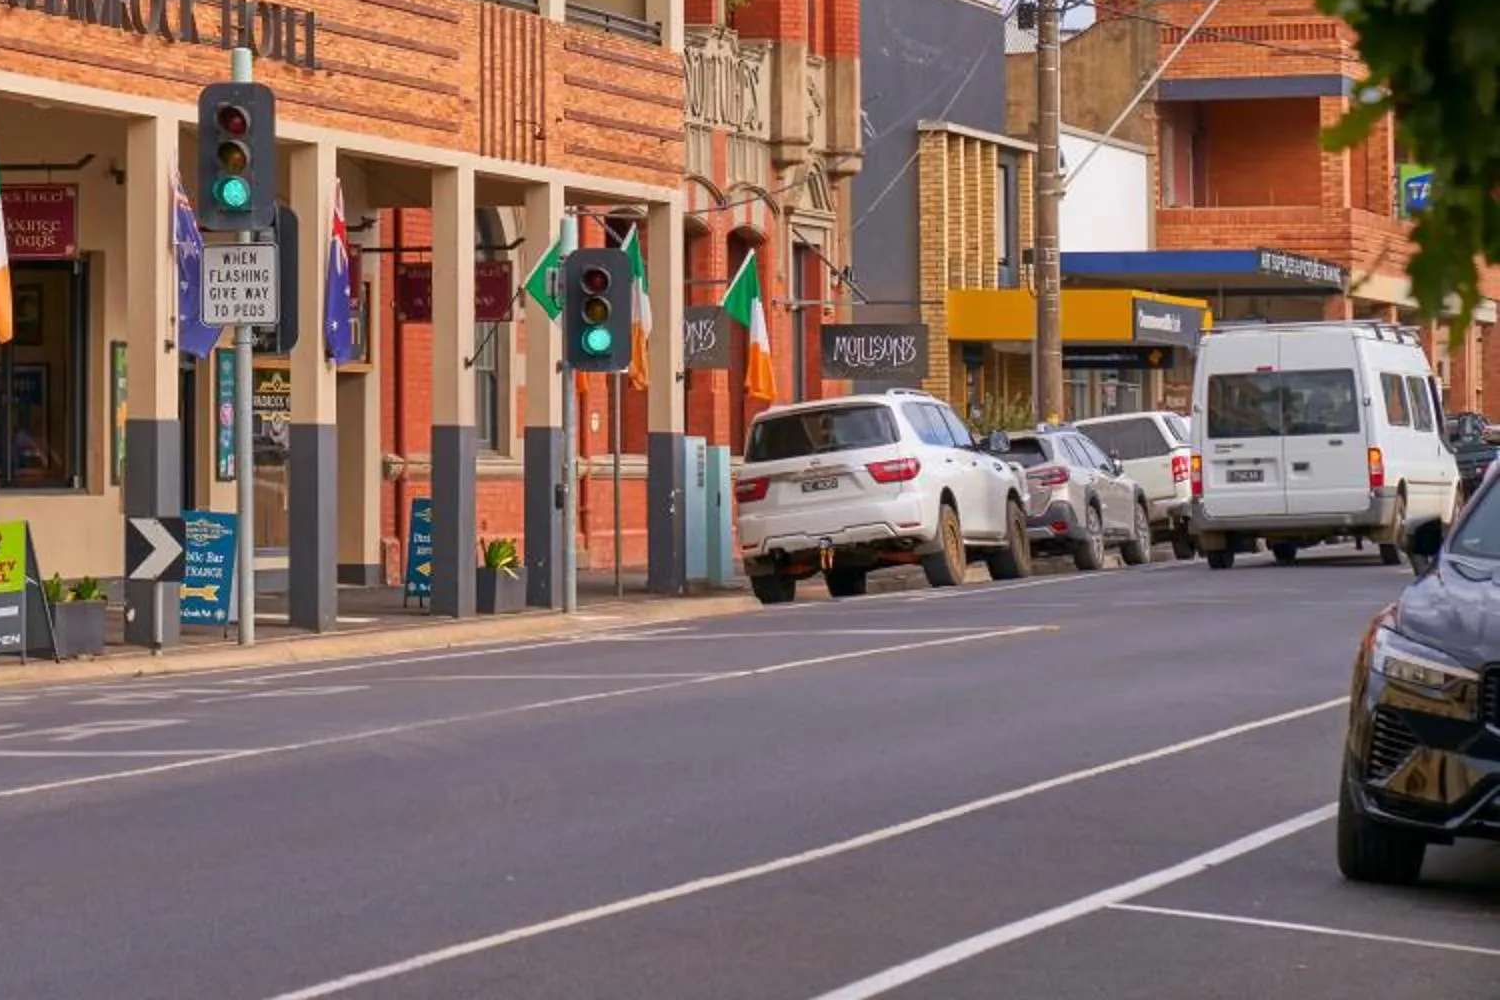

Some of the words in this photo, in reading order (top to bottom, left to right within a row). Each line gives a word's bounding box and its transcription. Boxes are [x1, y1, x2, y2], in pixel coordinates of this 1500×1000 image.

[223, 251, 257, 265] WHEN
[209, 269, 269, 283] FLASHING
[209, 287, 237, 300] GIVE
[245, 287, 269, 299] WAY
[214, 304, 229, 317] TO
[233, 303, 265, 317] PEDS
